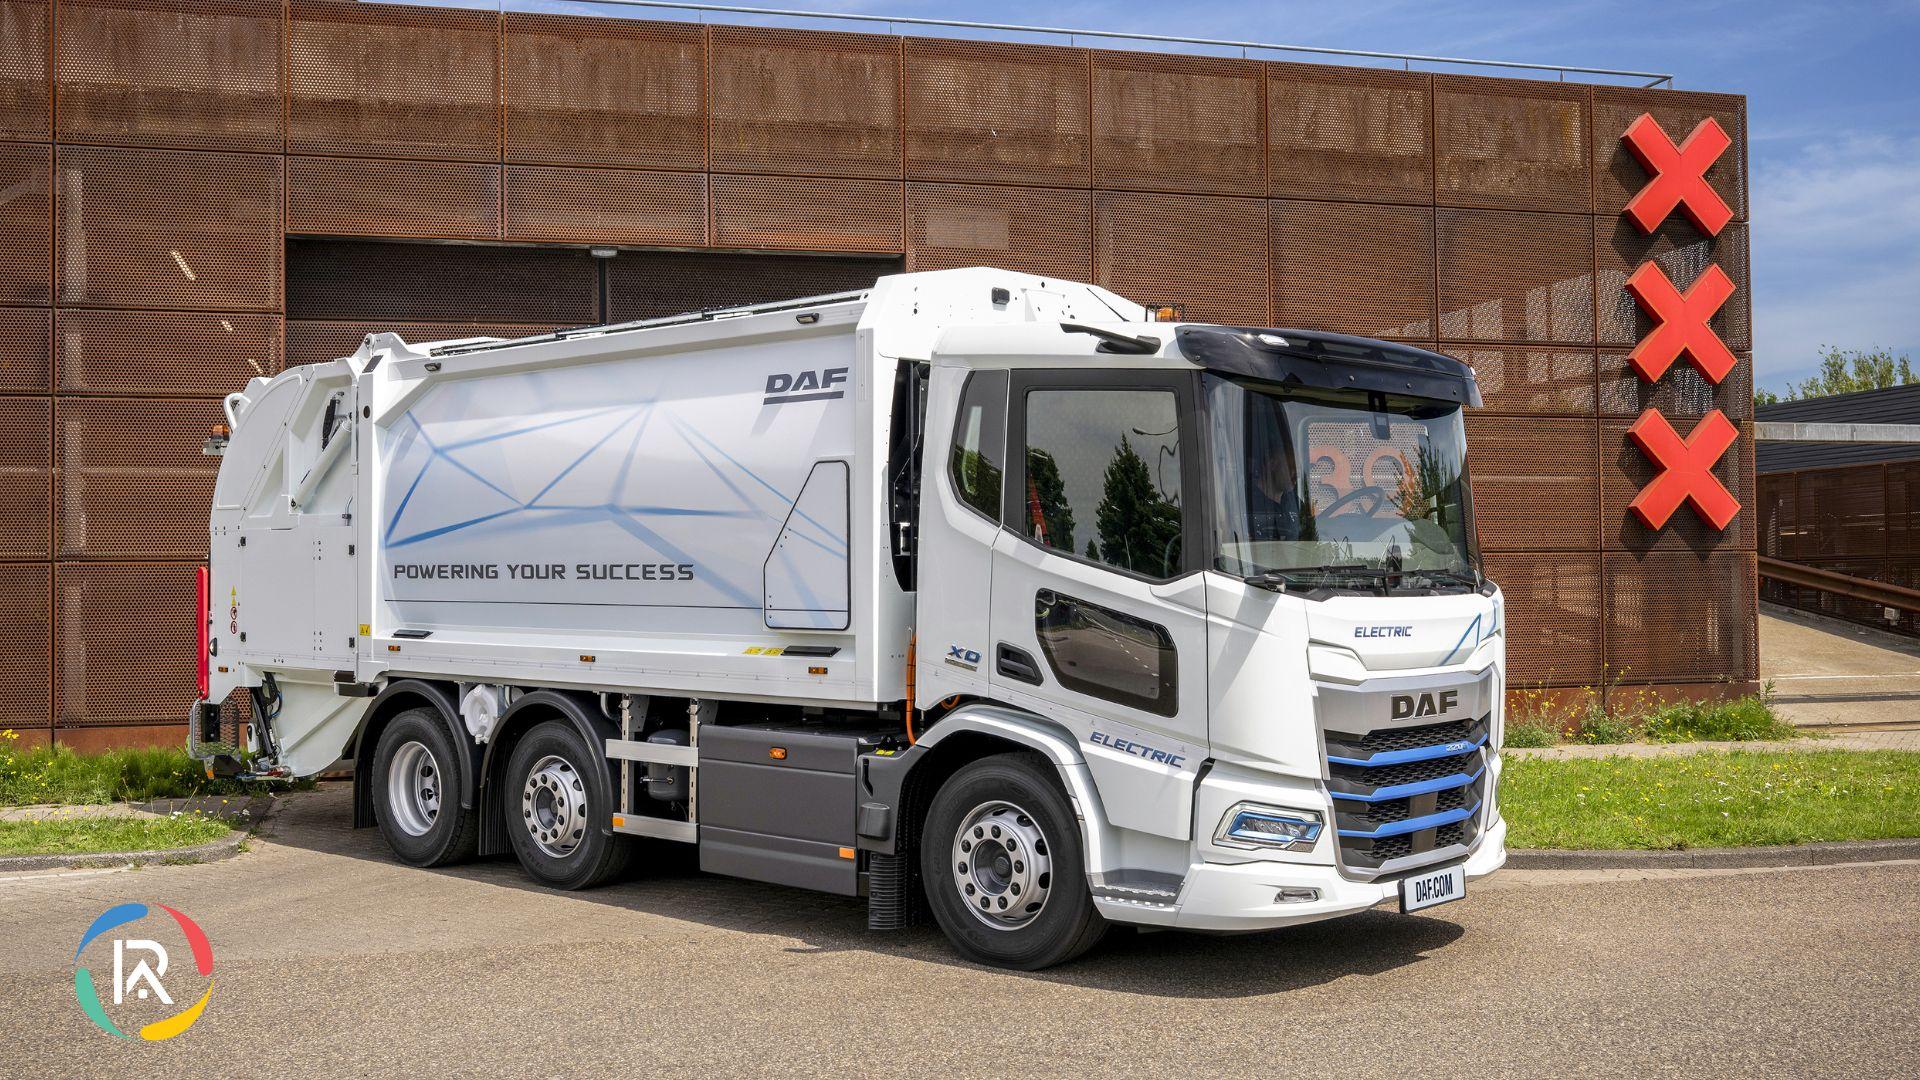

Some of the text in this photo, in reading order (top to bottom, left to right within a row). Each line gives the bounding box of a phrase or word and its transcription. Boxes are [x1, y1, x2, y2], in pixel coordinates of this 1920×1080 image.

[765, 367, 848, 393] DAF
[394, 564, 694, 580] POWERING YOUR SUCCESS
[1354, 625, 1413, 638] ELECTRIC
[947, 645, 982, 663] XD
[1391, 690, 1458, 720] DAF
[1090, 731, 1186, 768] ELECTRIC
[1416, 873, 1453, 902] DAF.COM
